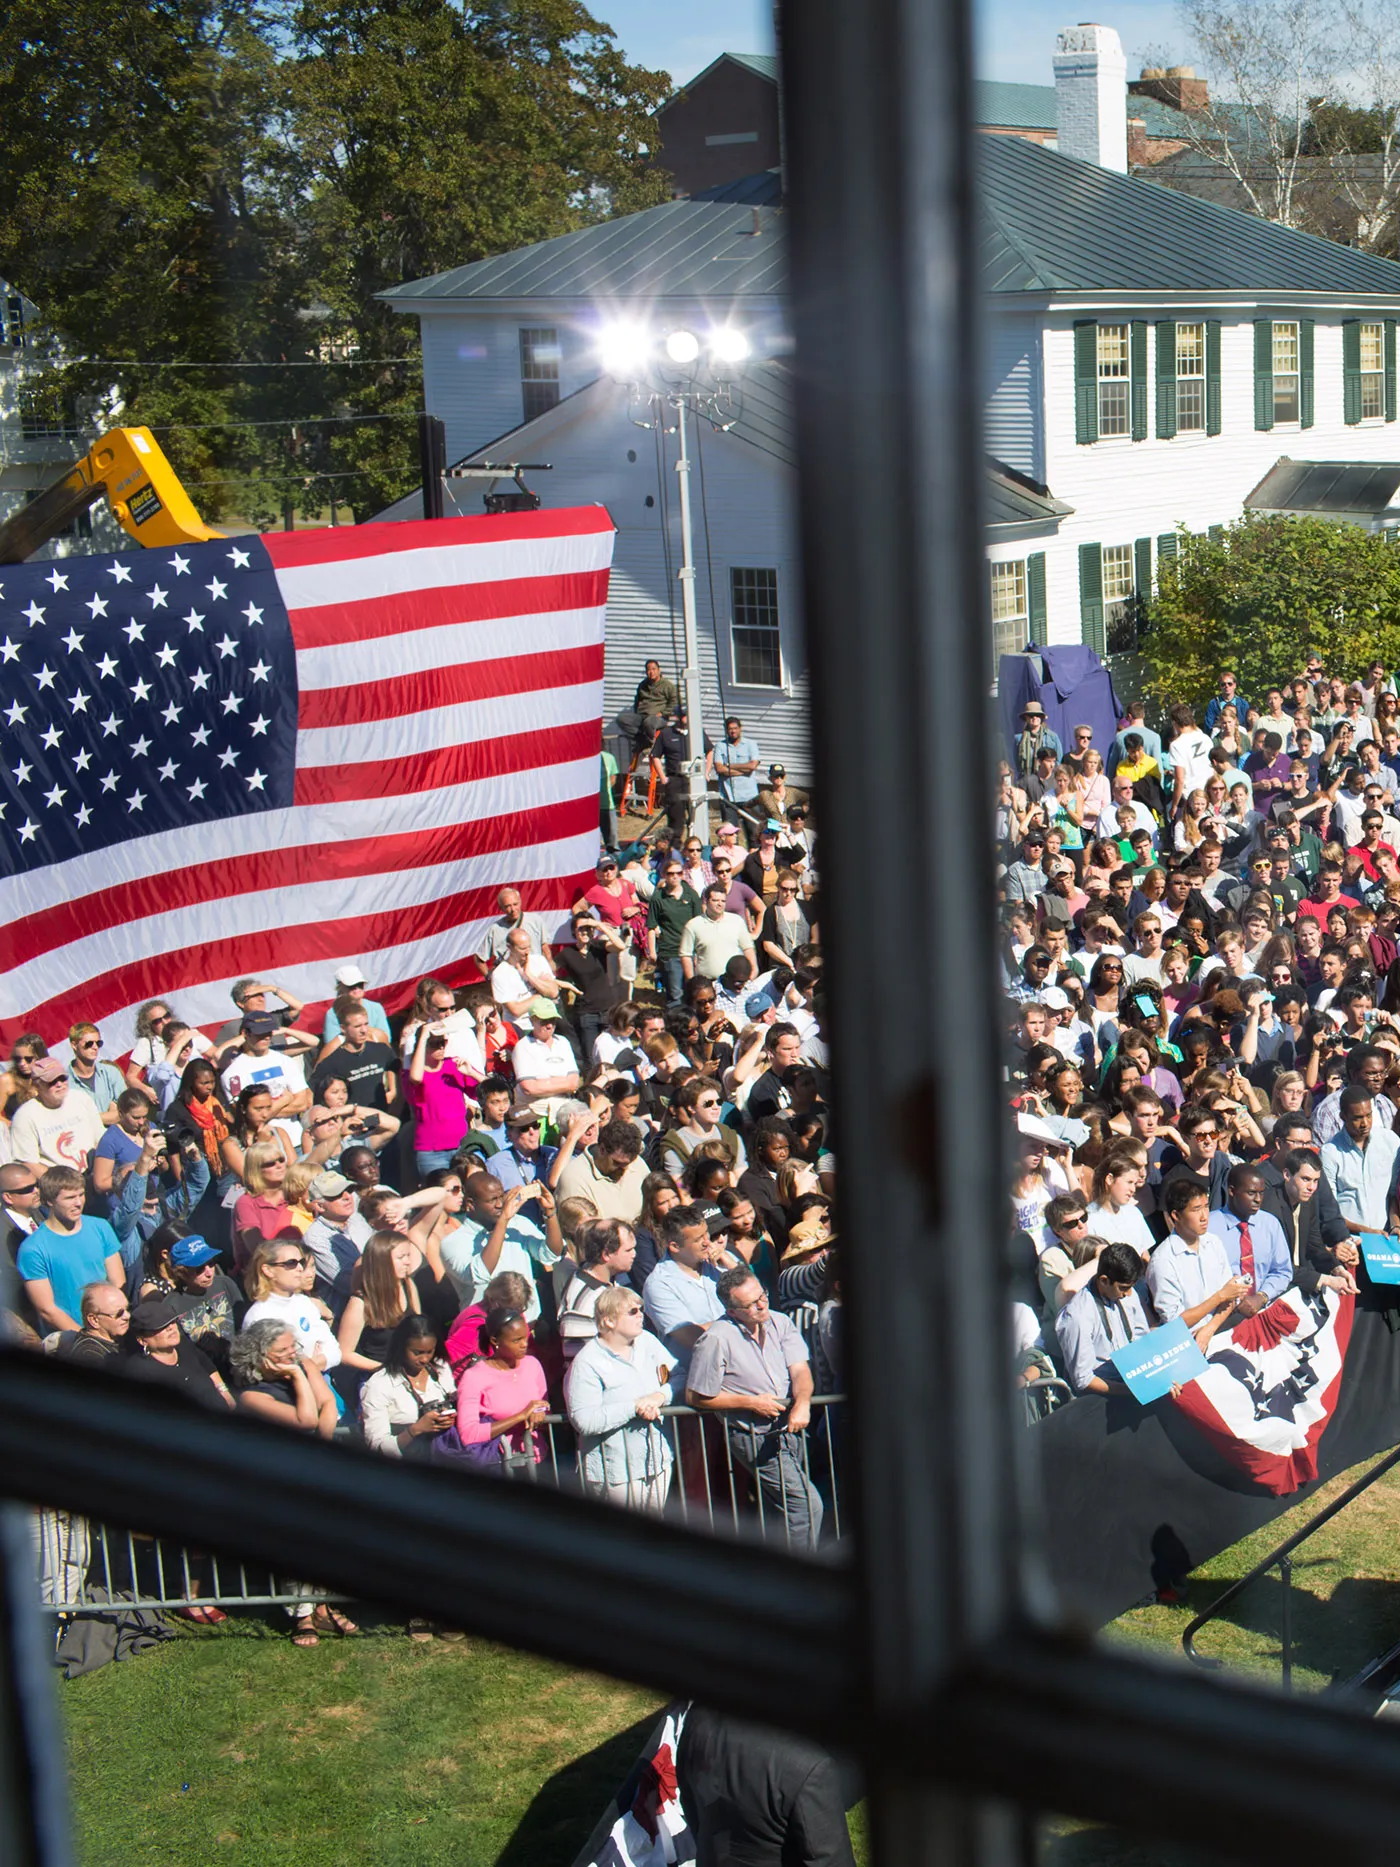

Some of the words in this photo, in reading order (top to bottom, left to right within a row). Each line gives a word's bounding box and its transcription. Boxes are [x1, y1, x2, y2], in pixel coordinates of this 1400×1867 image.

[130, 487, 154, 511] Hertz
[1366, 1253, 1392, 1261] OBAMA
[1125, 1361, 1154, 1380] OBAMA
[1161, 1339, 1191, 1360] BIDEN
